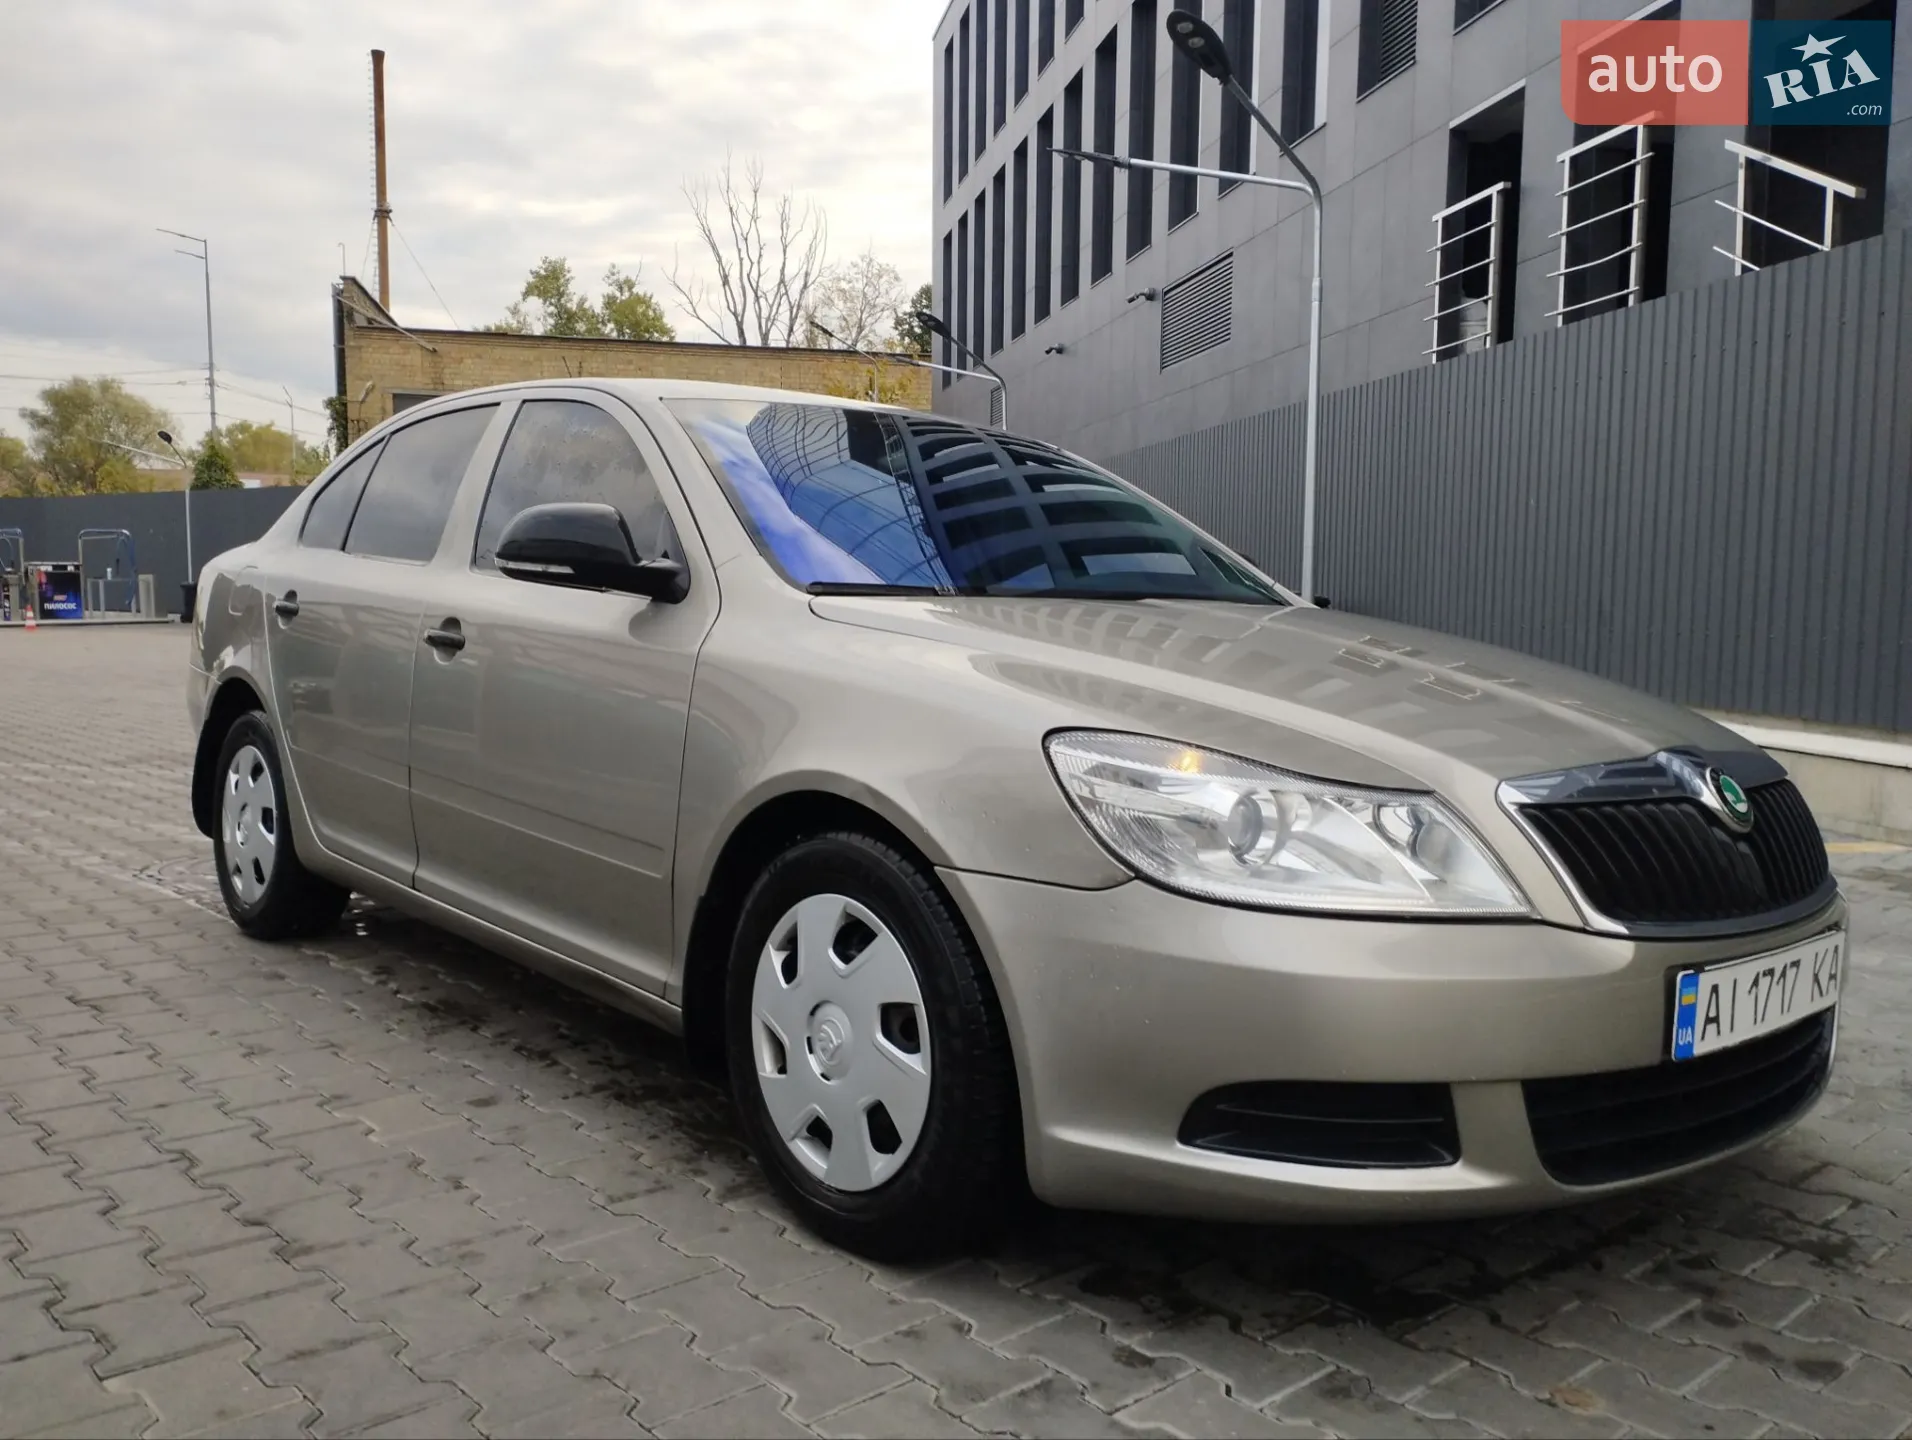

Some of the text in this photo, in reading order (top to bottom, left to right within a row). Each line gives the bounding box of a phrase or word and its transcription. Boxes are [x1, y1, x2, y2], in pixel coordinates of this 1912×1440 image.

[1701, 944, 1839, 1041] AI 1717 KA
[1678, 1025, 1693, 1046] UA
